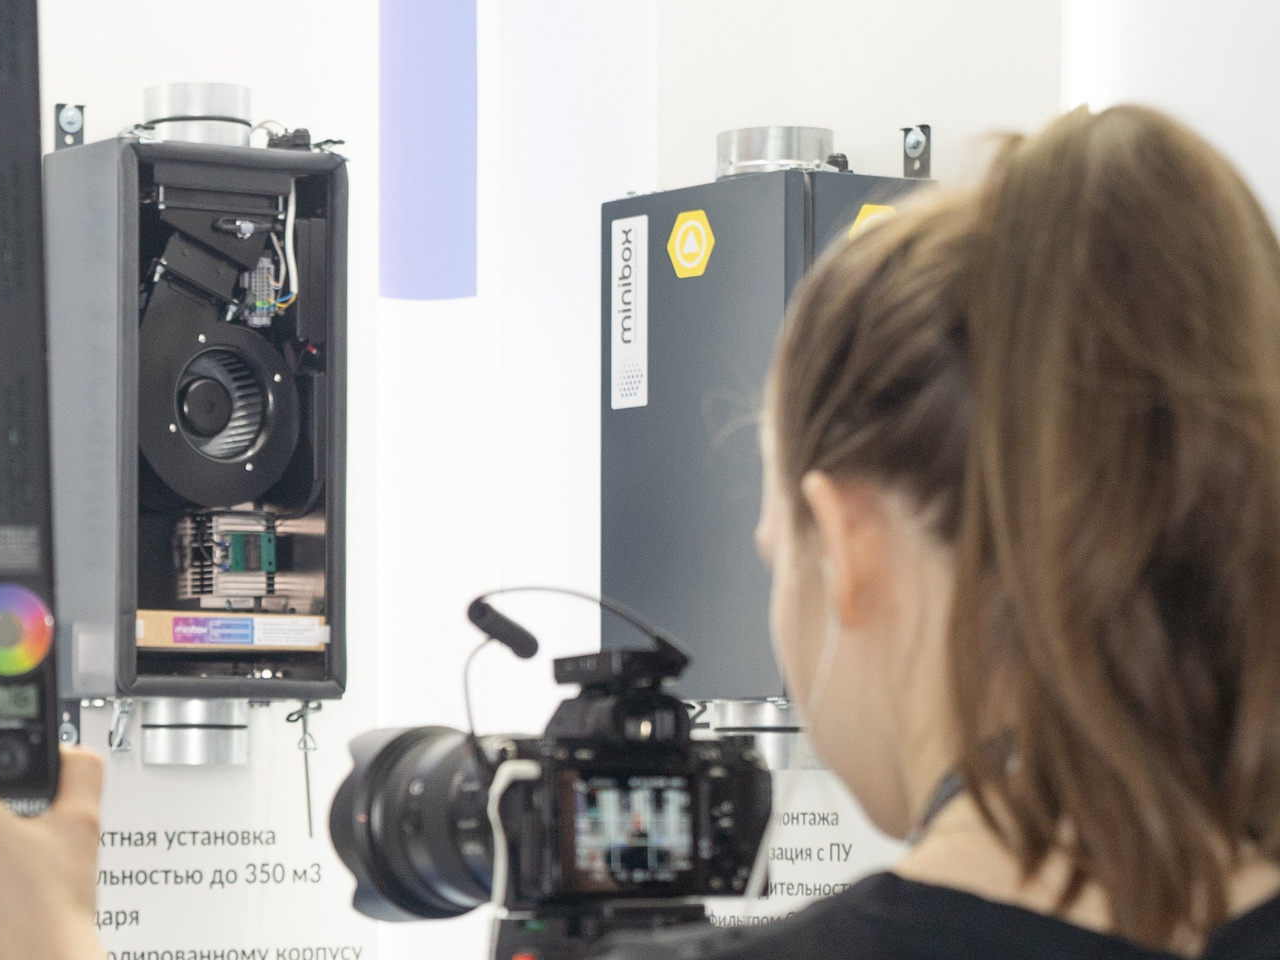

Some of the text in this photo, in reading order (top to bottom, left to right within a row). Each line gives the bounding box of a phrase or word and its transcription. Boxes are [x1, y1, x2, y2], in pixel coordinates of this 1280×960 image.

[618, 228, 633, 345] minibox
[778, 811, 839, 827] онтажа
[99, 830, 276, 851] ктная установка
[769, 843, 853, 864] зация с ПУ
[97, 862, 322, 889] льностью до 350 м3
[768, 881, 853, 898] ительност
